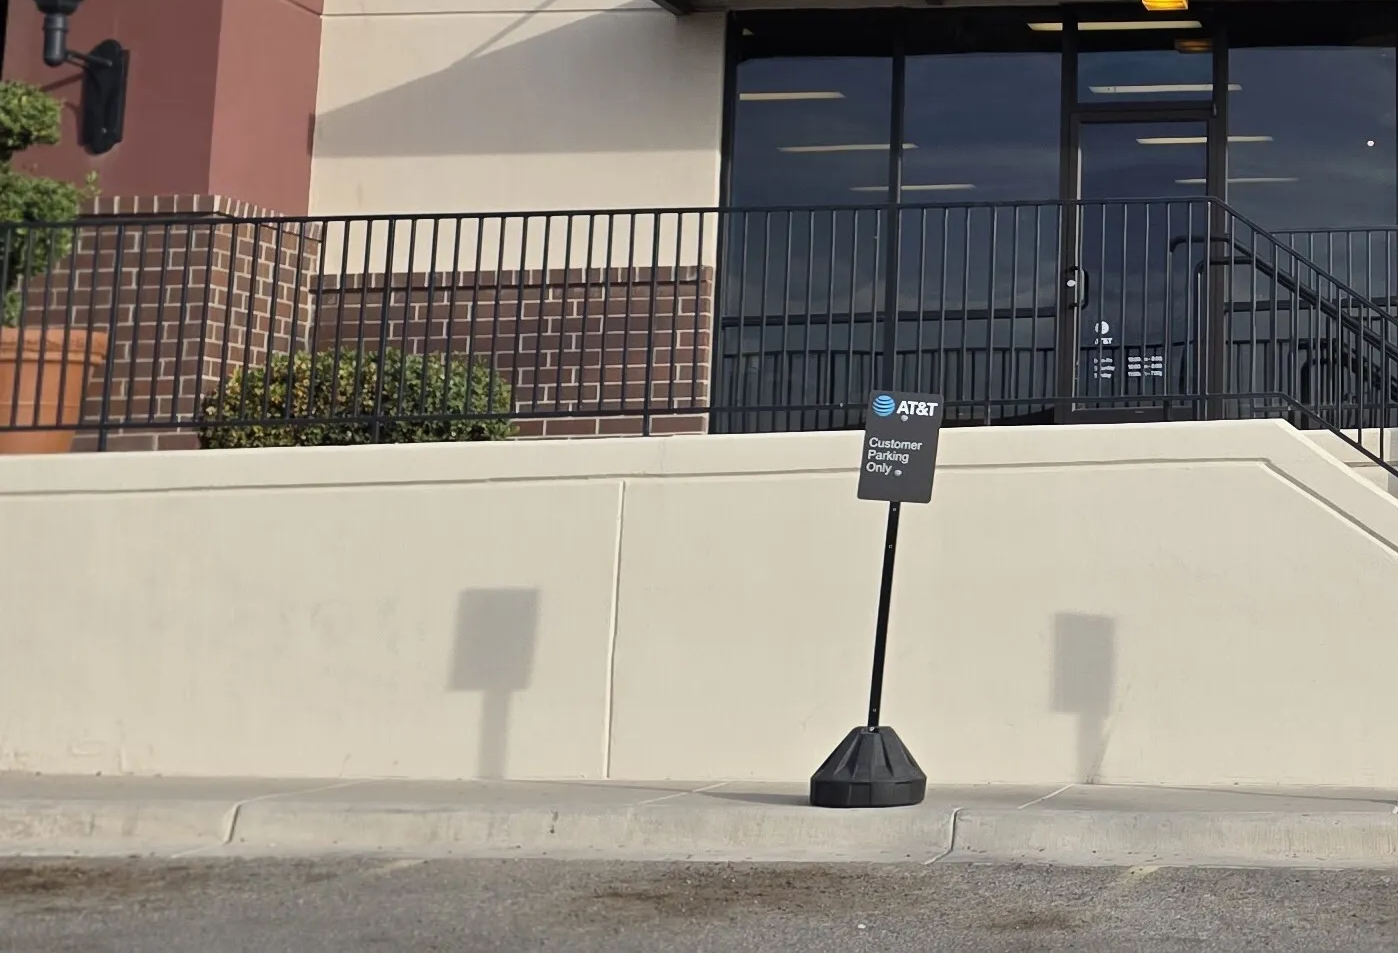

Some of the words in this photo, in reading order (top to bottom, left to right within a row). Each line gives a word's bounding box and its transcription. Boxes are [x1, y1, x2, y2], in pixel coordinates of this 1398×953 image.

[896, 400, 939, 417] AT&T
[868, 437, 923, 451] Customer
[867, 449, 910, 464] Parking
[866, 462, 893, 476] Only
